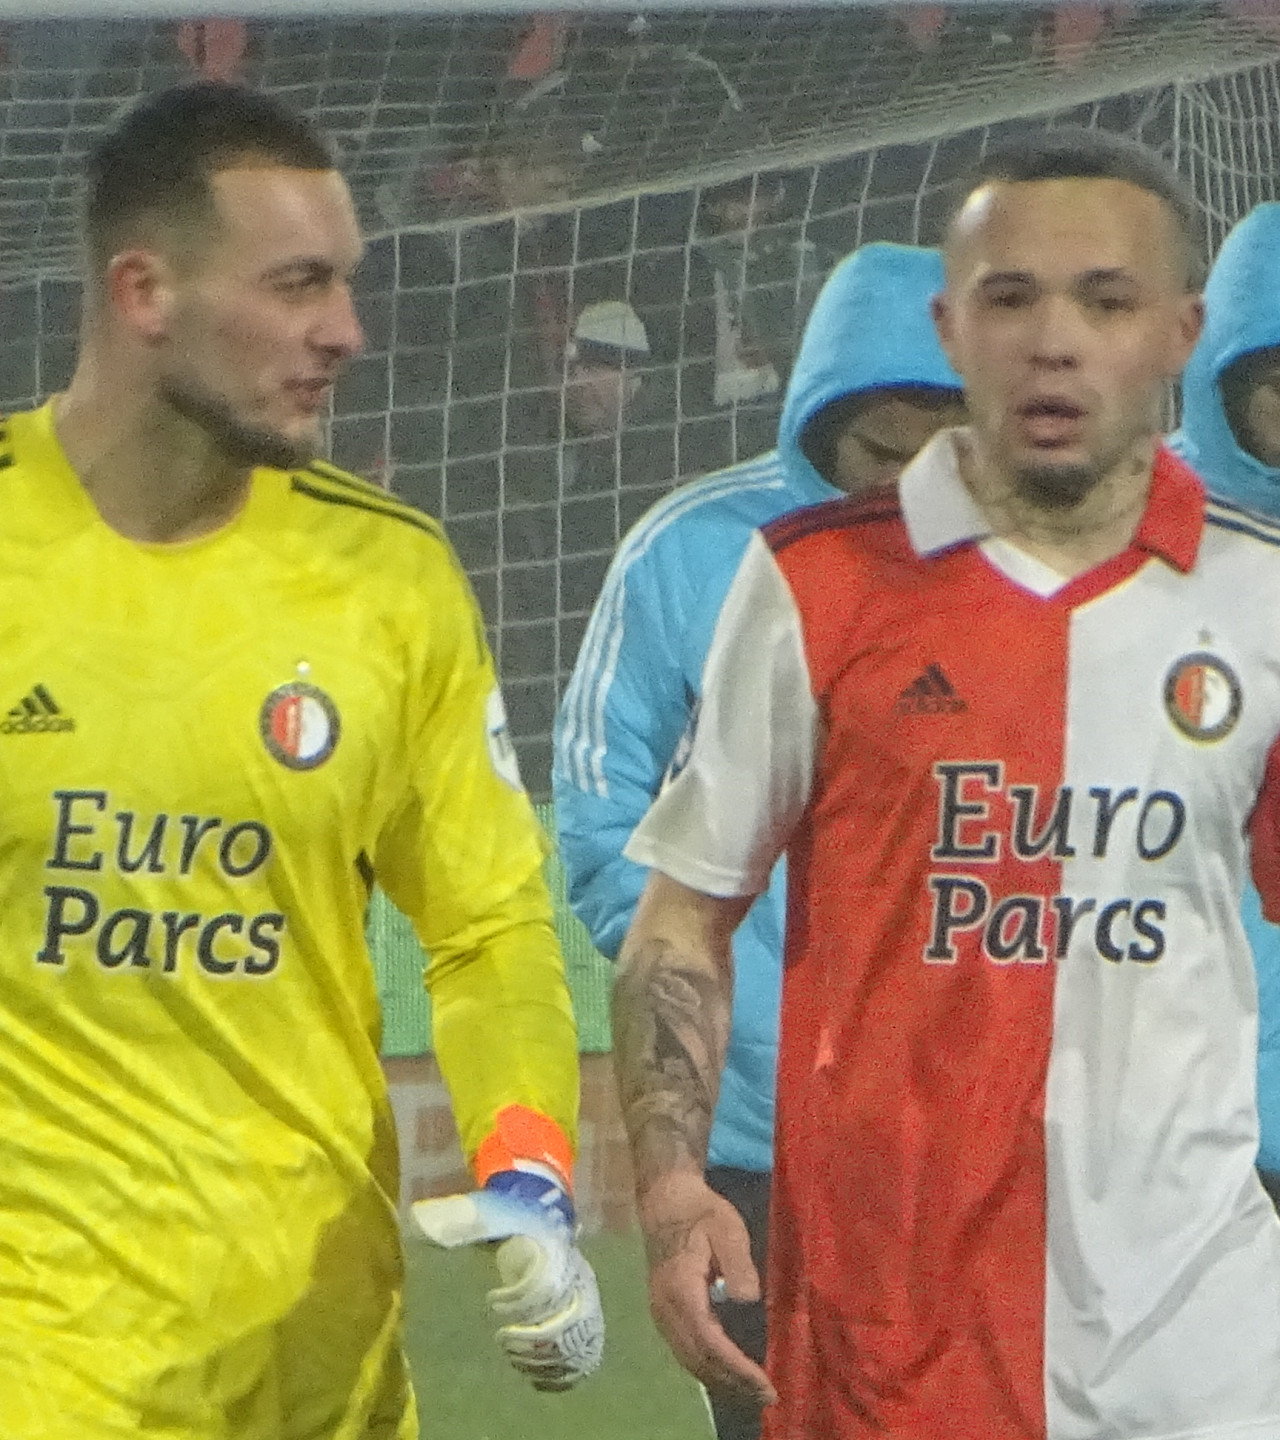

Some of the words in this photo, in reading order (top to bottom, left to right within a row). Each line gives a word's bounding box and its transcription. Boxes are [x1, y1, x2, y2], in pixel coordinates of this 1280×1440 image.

[45, 789, 273, 877] Euro
[931, 763, 1187, 861] Euro
[37, 885, 286, 976] Parcs
[923, 876, 1167, 964] Parcs
